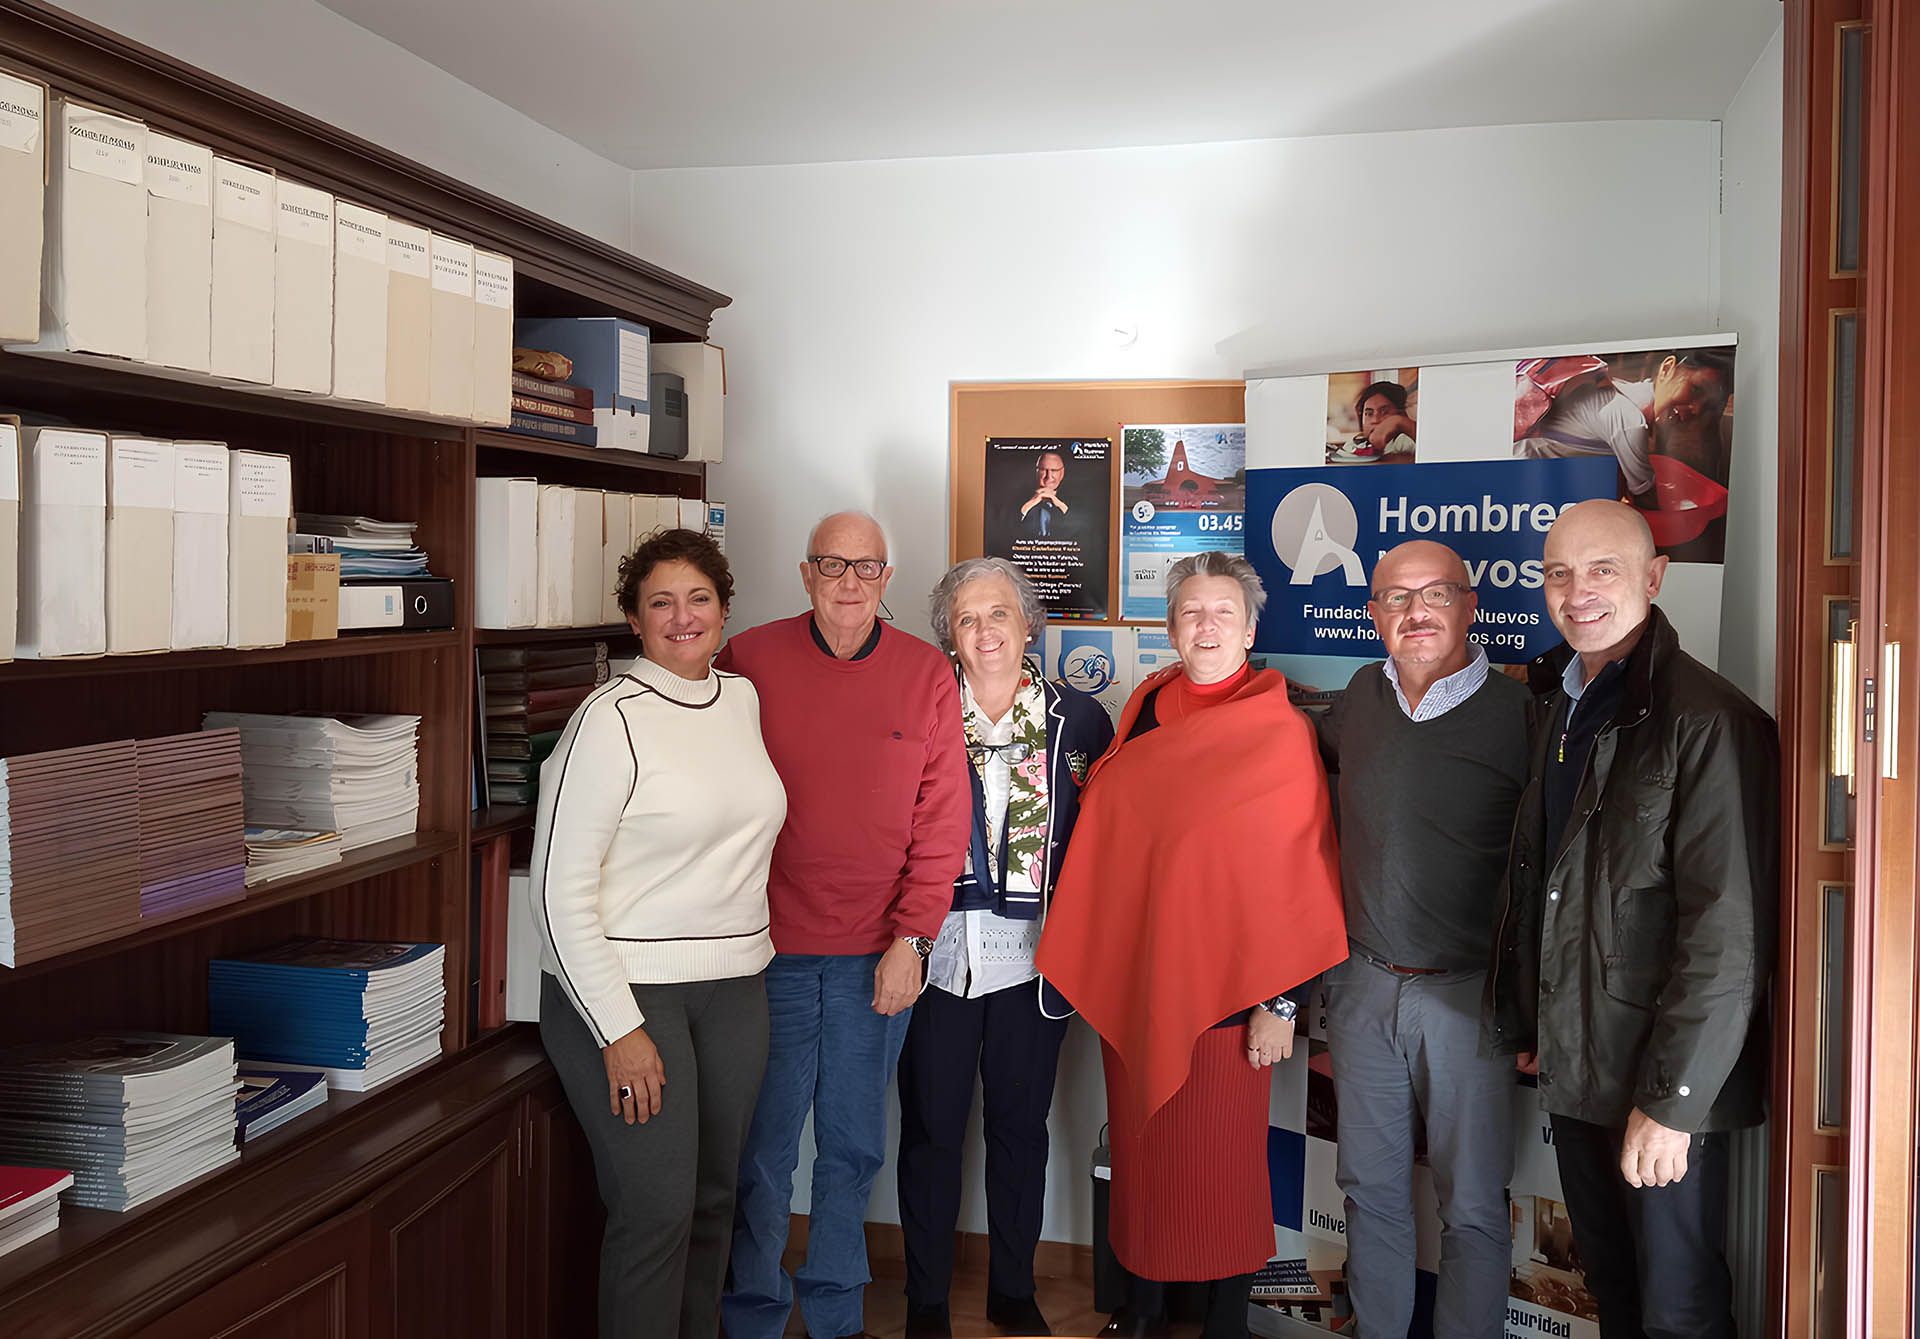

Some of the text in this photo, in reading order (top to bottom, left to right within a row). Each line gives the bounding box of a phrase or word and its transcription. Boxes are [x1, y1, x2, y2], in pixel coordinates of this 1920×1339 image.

[1198, 514, 1243, 531] 03.45
[1379, 495, 1577, 533] Hombre
[1303, 604, 1540, 625] Fundaci Nuevos
[1309, 1208, 1345, 1234] Unive
[1505, 1307, 1571, 1338] eguridad
